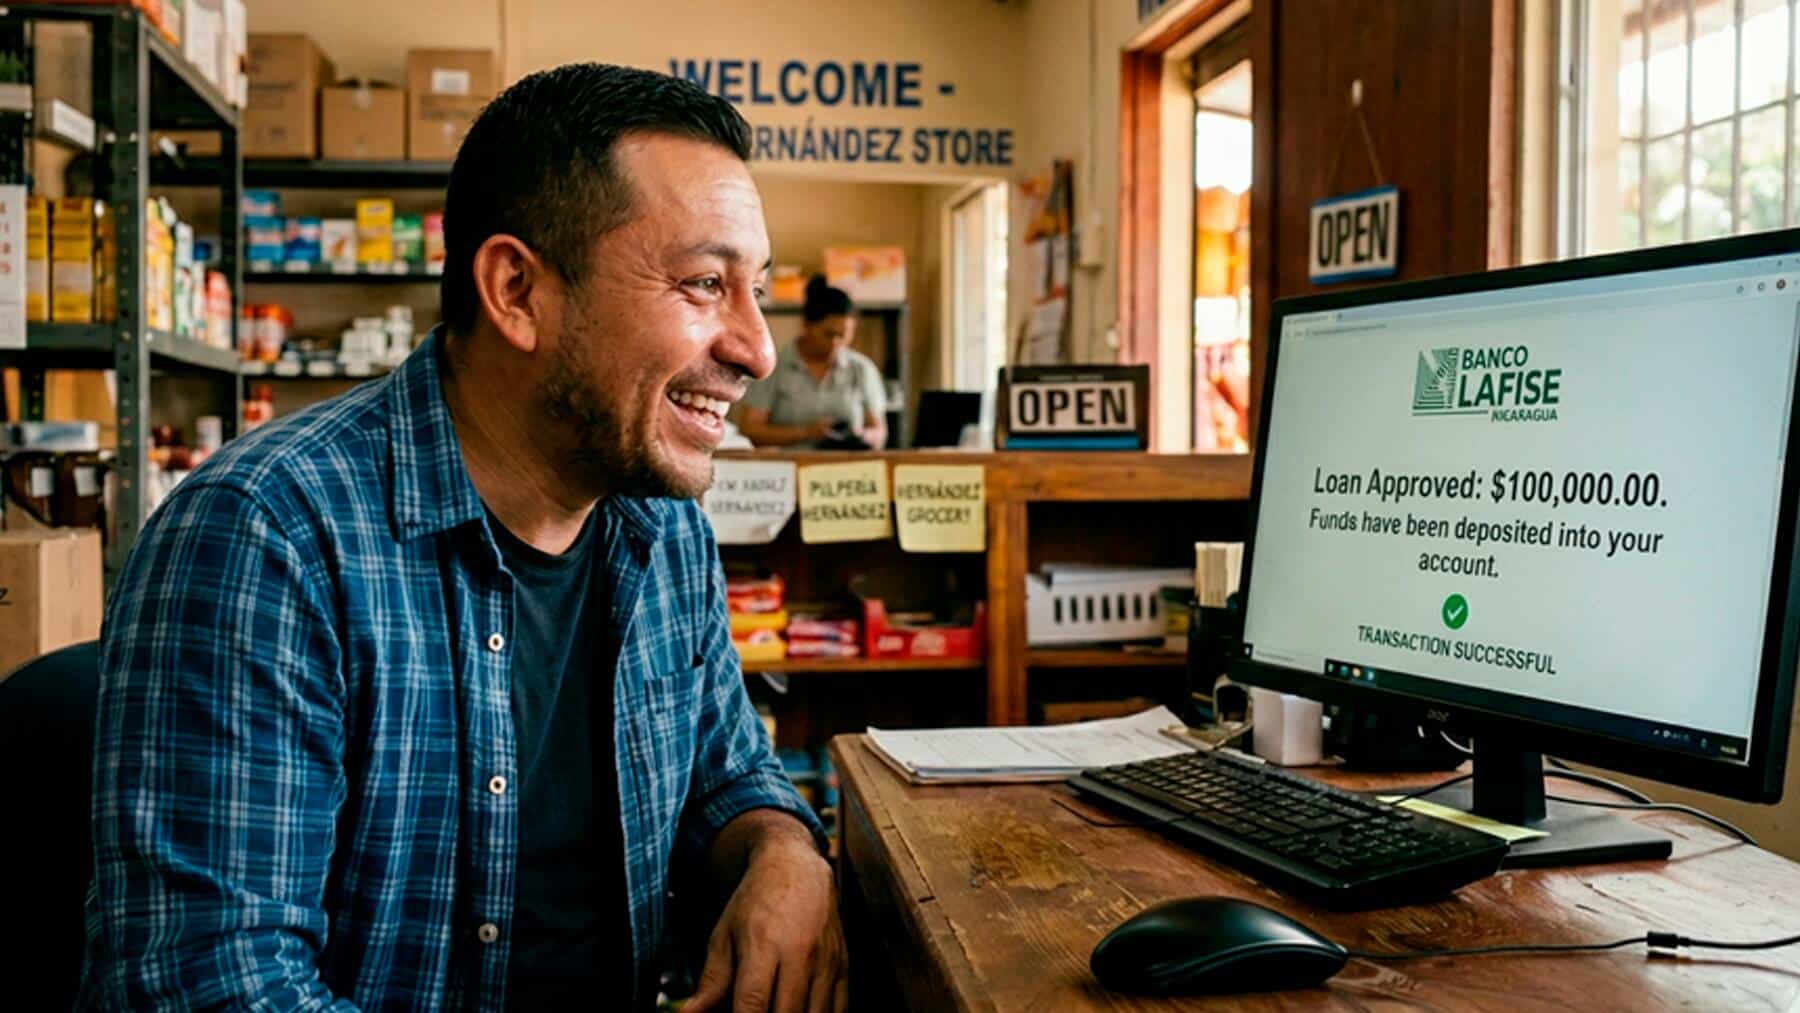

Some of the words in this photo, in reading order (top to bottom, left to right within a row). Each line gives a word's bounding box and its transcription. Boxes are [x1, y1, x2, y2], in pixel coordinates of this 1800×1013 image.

[669, 59, 922, 107] WELCOME
[752, 115, 904, 163] RNÁNDEZ
[913, 129, 1013, 166] STORE
[1317, 202, 1390, 268] OPEN
[1462, 345, 1529, 370] BANCO
[1018, 388, 1127, 426] OPEN
[1458, 368, 1562, 408] LAFISE
[1491, 408, 1558, 422] NICARAGUA
[1314, 467, 1362, 495] Loan
[1366, 468, 1482, 502] Approved:
[1490, 469, 1668, 508] $100,000.00.
[1309, 508, 1358, 532] Funds
[1361, 510, 1402, 535] have
[1406, 513, 1450, 538] been
[1455, 517, 1552, 547] deposited
[1558, 522, 1601, 550] into
[1607, 530, 1664, 557] your
[1418, 553, 1499, 578] account.
[1358, 625, 1451, 657] TRANSACTION
[1453, 640, 1557, 675] SUCCESSFUL
